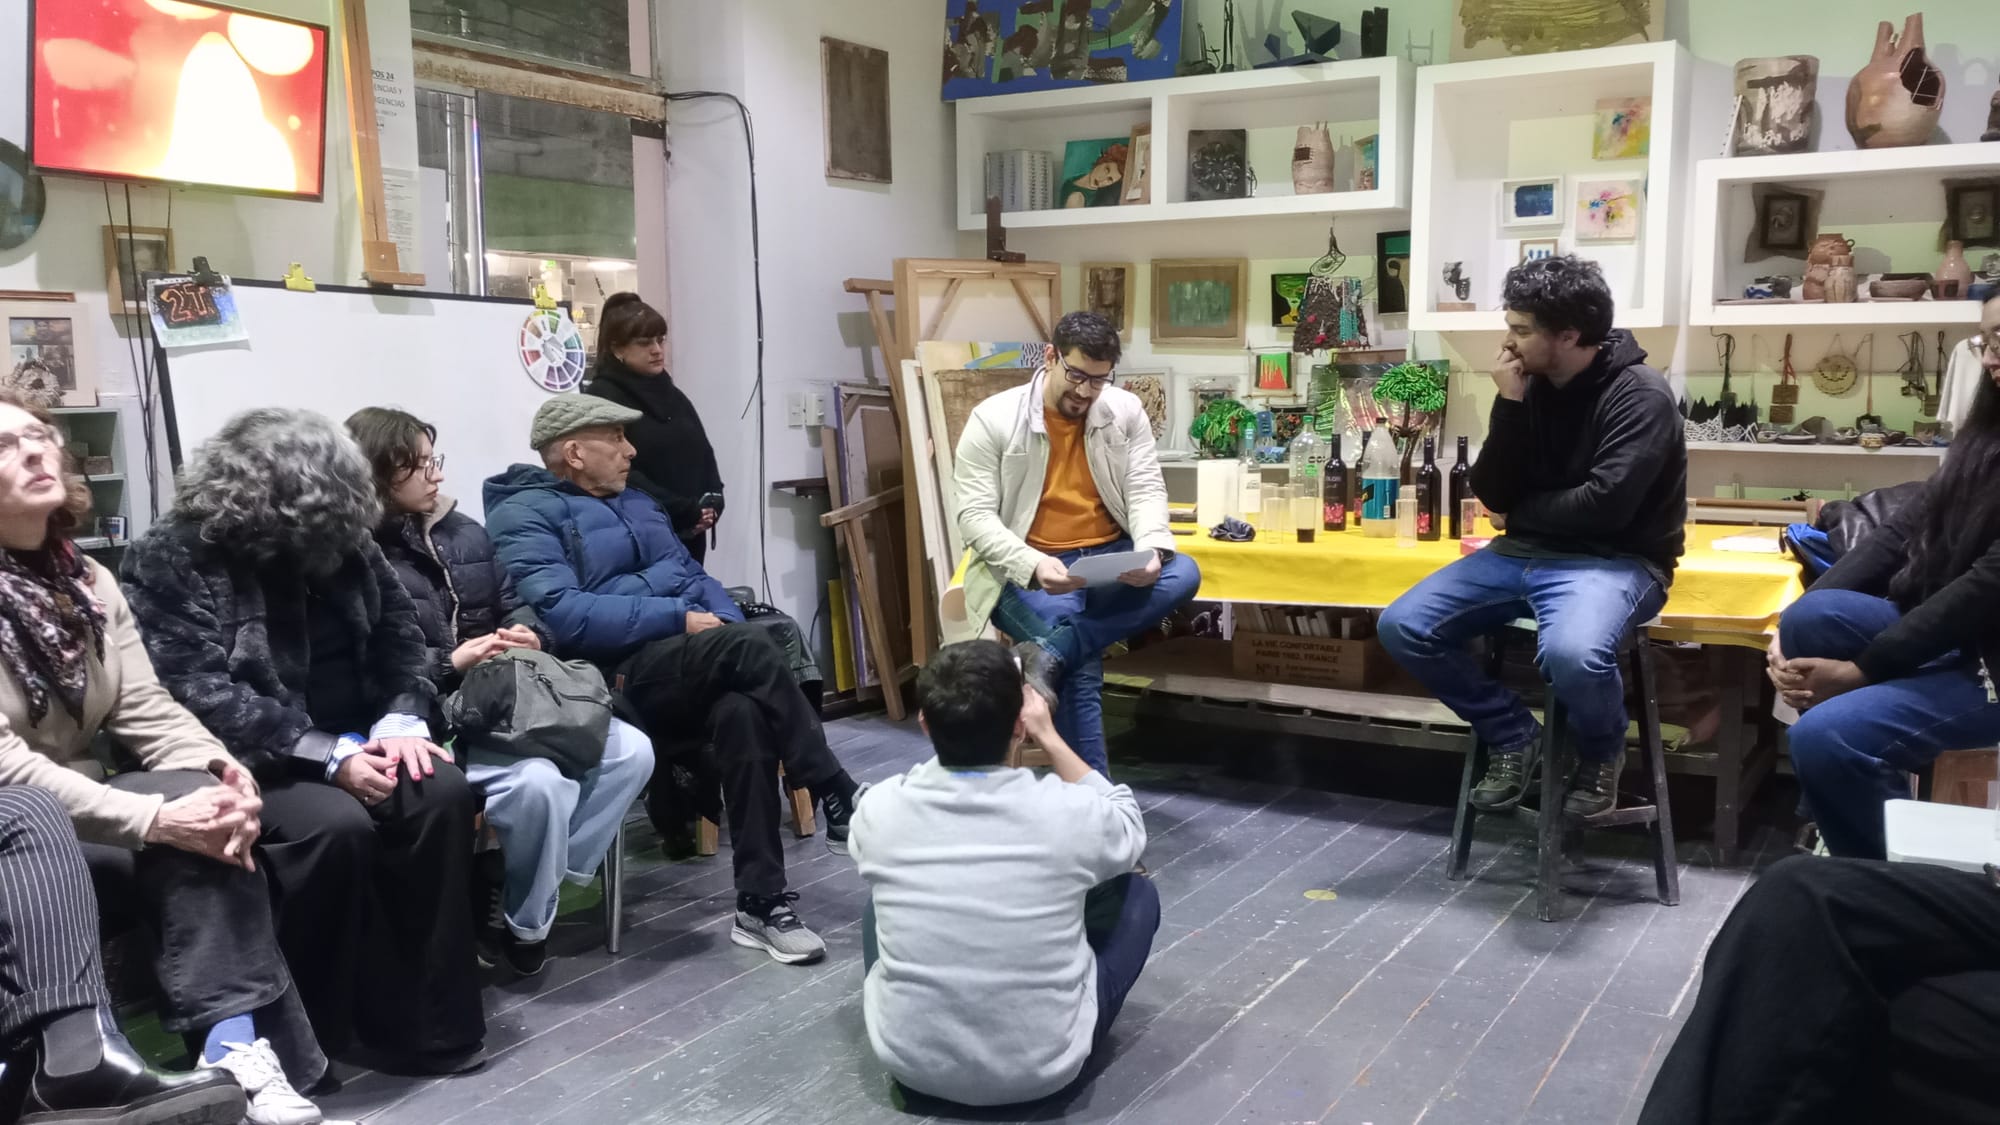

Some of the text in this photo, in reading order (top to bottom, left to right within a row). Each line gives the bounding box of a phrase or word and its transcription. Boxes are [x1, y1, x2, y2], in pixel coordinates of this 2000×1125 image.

[1252, 639, 1342, 653] LA VIE CONFORTABLE
[1304, 653, 1338, 664] FRANCE
